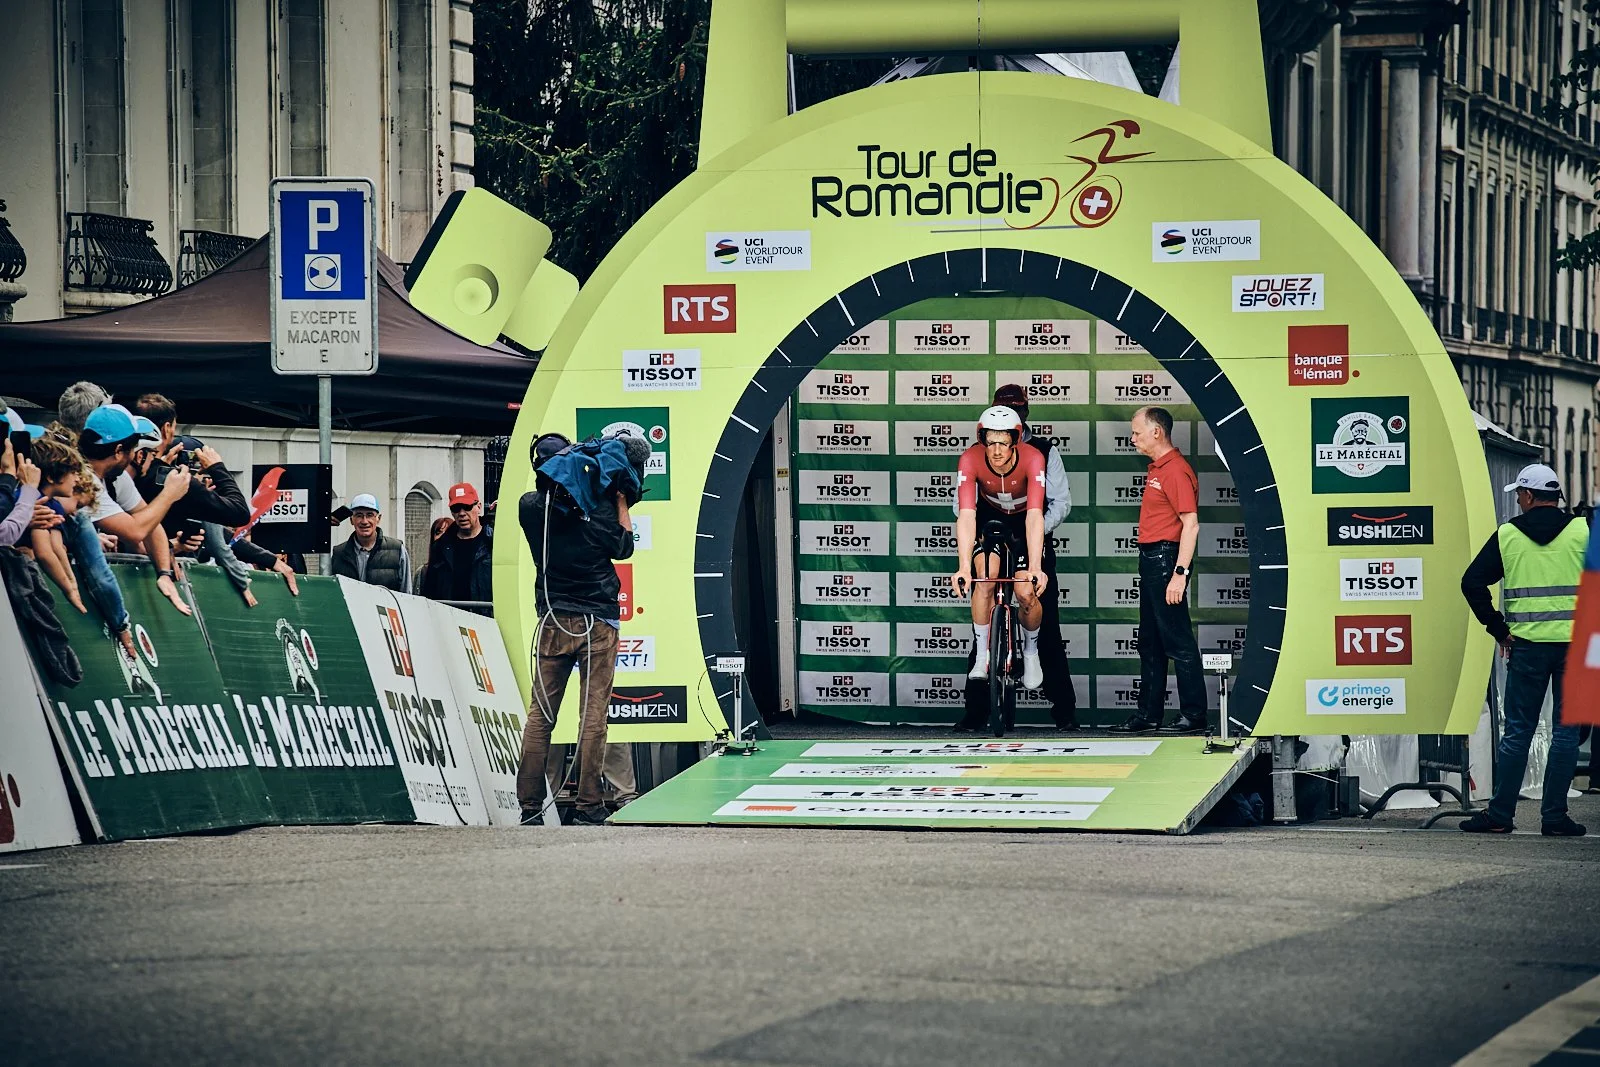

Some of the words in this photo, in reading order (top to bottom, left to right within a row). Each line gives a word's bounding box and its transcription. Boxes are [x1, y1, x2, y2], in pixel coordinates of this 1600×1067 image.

[857, 145, 936, 179] Tour
[949, 143, 996, 177] de
[812, 172, 1043, 218] Romandie
[309, 200, 339, 250] P
[1191, 228, 1212, 237] UCI
[744, 238, 764, 247] UCI
[1191, 236, 1252, 246] WORLDTOUR
[744, 246, 803, 256] WORLDTOUR
[1192, 246, 1222, 255] EVENT
[745, 256, 775, 265] EVENT
[1242, 277, 1313, 293] JOUEZ
[1239, 292, 1317, 308] SPORT!
[671, 296, 730, 322] RTS
[290, 311, 357, 325] EXCEPTE
[287, 330, 361, 344] MACARON
[914, 336, 970, 346] TISSOT
[1014, 335, 1070, 345] TISSOT
[319, 349, 329, 363] E
[1294, 353, 1343, 367] banque
[627, 367, 697, 381] TISSOT
[1303, 368, 1343, 379] léman
[816, 384, 870, 396] TISSOT
[914, 386, 970, 396] TISSOT
[1114, 386, 1172, 396] TISSOT
[816, 435, 872, 446] TISSOT
[914, 436, 970, 447] TISSOT
[1319, 450, 1333, 460] LE
[1337, 448, 1402, 460] MARÉCHAL
[816, 486, 872, 496] TISSOT
[914, 487, 956, 498] TISSO
[1338, 524, 1424, 539] SUSHIZEN
[816, 536, 870, 546] TISSOT
[914, 538, 958, 548] TISSO
[1345, 576, 1418, 590] TISSOT
[816, 587, 871, 598] TISSOT
[816, 637, 870, 648] TISSOT
[914, 638, 970, 649] TISSOT
[1343, 627, 1405, 653] RTS
[816, 687, 872, 698] TISSOT
[1342, 684, 1391, 697] primeo
[1342, 695, 1394, 709] energie
[607, 703, 678, 718] USHIZEN
[232, 694, 278, 768] LE
[384, 690, 456, 768] TISSOT
[58, 701, 115, 778] LE
